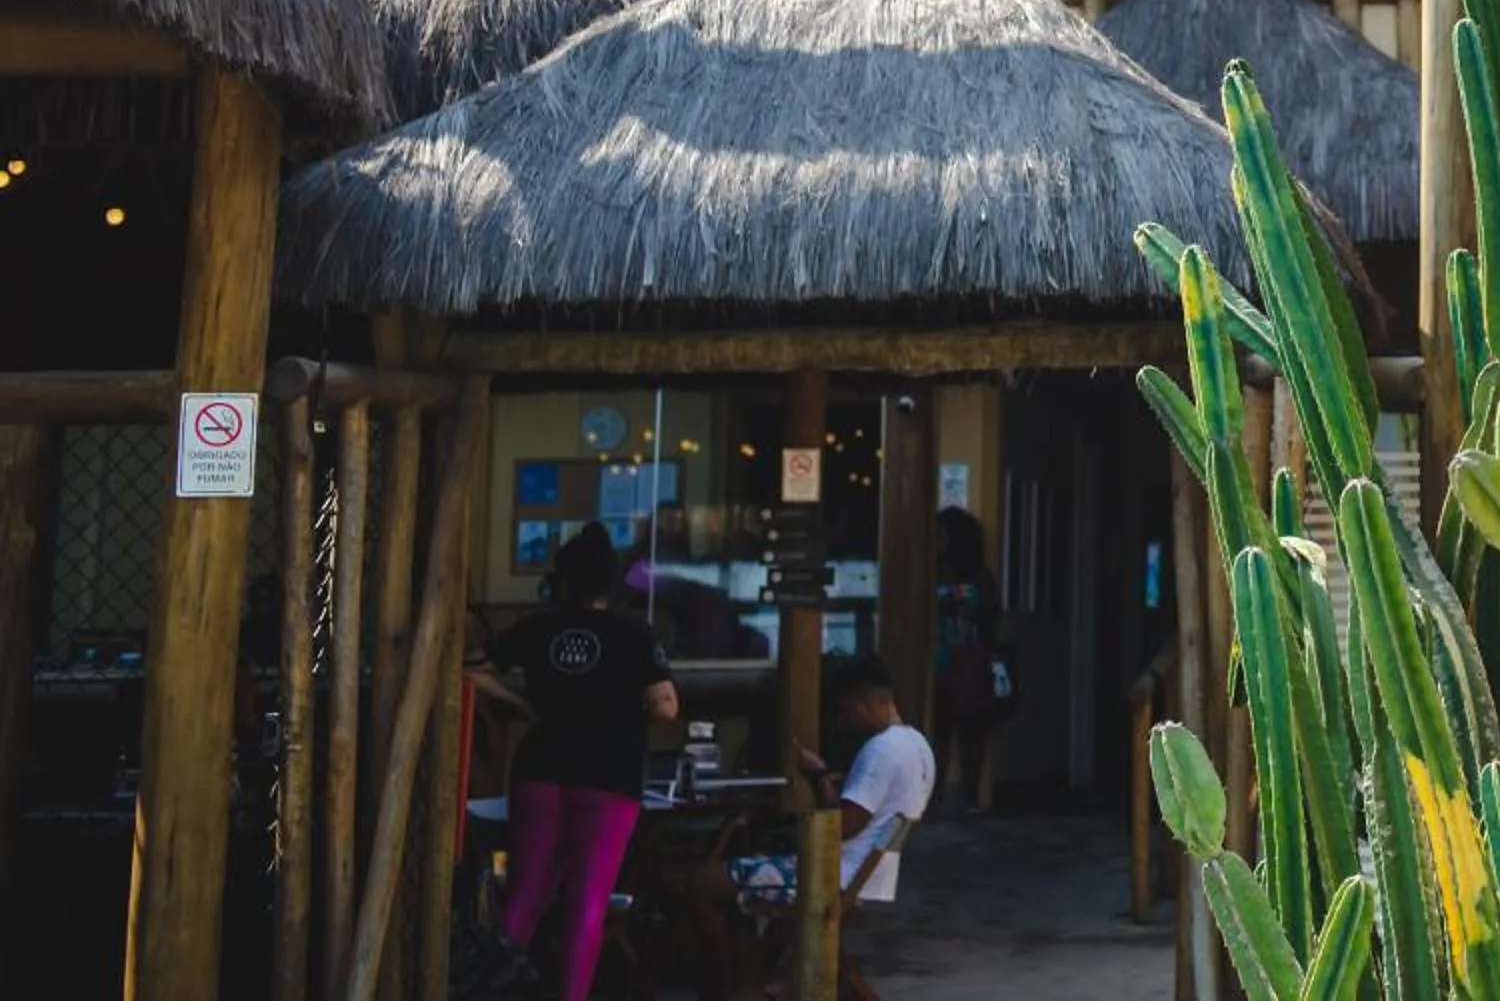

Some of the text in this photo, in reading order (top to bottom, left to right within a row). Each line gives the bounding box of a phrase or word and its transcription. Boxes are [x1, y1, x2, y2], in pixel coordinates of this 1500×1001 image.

[190, 449, 247, 461] OBRIGADO
[192, 462, 215, 472] POR
[196, 473, 235, 484] FUMAR
